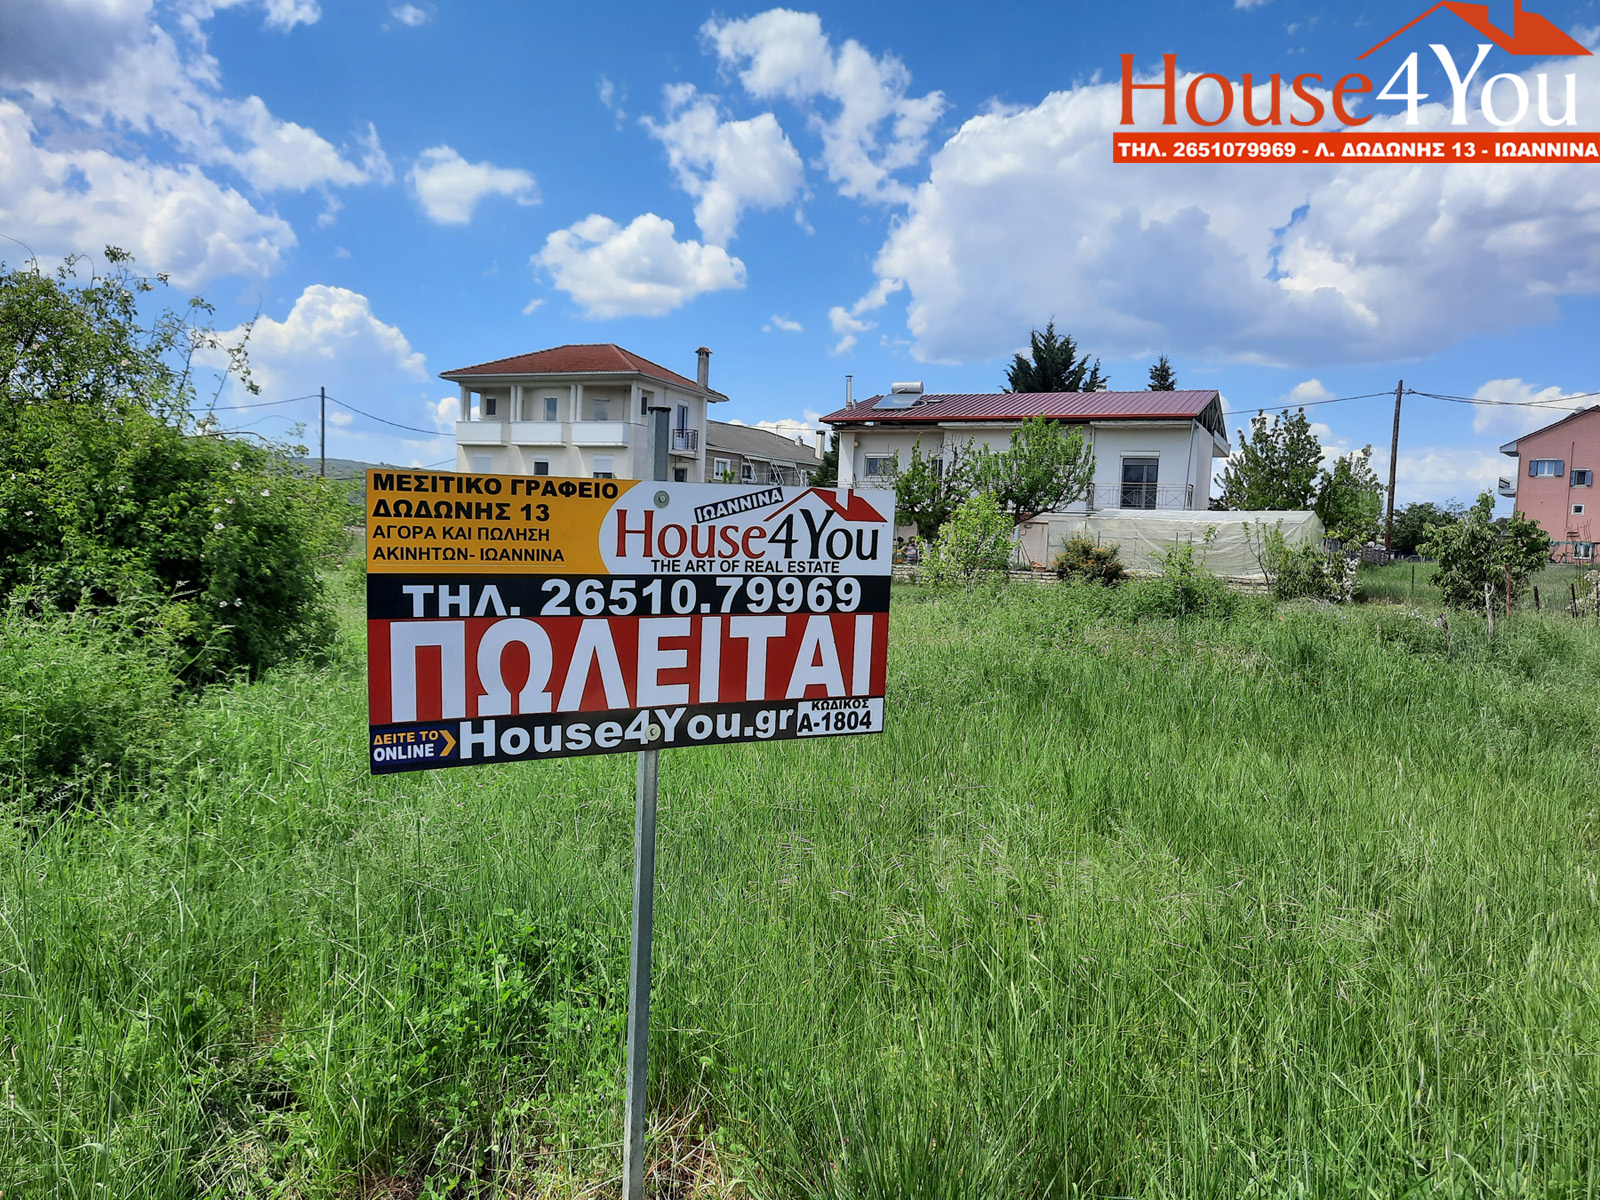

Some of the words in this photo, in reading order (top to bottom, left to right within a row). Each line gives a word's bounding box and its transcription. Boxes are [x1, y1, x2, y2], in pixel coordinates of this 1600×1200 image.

[373, 473, 502, 495] ΜΕΣΙΤΙΚΟ
[510, 479, 619, 499] ΓΡΑΦΕΙΟ
[372, 499, 511, 521] ΔΩΔΩΝΗΣ
[520, 503, 550, 522] 13
[697, 489, 783, 522] ΙΩΑΝΝΙΝΑ
[372, 525, 437, 540] ΑΓΟΡΑ
[442, 526, 472, 540] ΚΑΙ
[477, 527, 550, 542] ΠΩΛΗΣΗ
[615, 508, 879, 560] House4You
[372, 546, 476, 561] ΑΚΙΝΗΤΩΝ-
[480, 548, 565, 562] ΙΩΑΝΝΙΝΑ
[651, 560, 681, 573] THE
[685, 560, 716, 573] ART
[720, 560, 741, 573] OF
[745, 561, 783, 573] REAL
[787, 561, 840, 574] ESTATE
[402, 584, 521, 618] ΤΗΛ.
[540, 576, 862, 617] 26510.79969
[390, 615, 874, 722] ΠΩΛΕΙΤΑΙ
[811, 699, 870, 711] ΚΩΔΙΚΟΣ
[373, 731, 416, 746] ΔΕΙΤΕ
[419, 730, 439, 741] ΤΟ
[459, 707, 795, 759] House4You.gr
[373, 744, 435, 762] ONLINE
